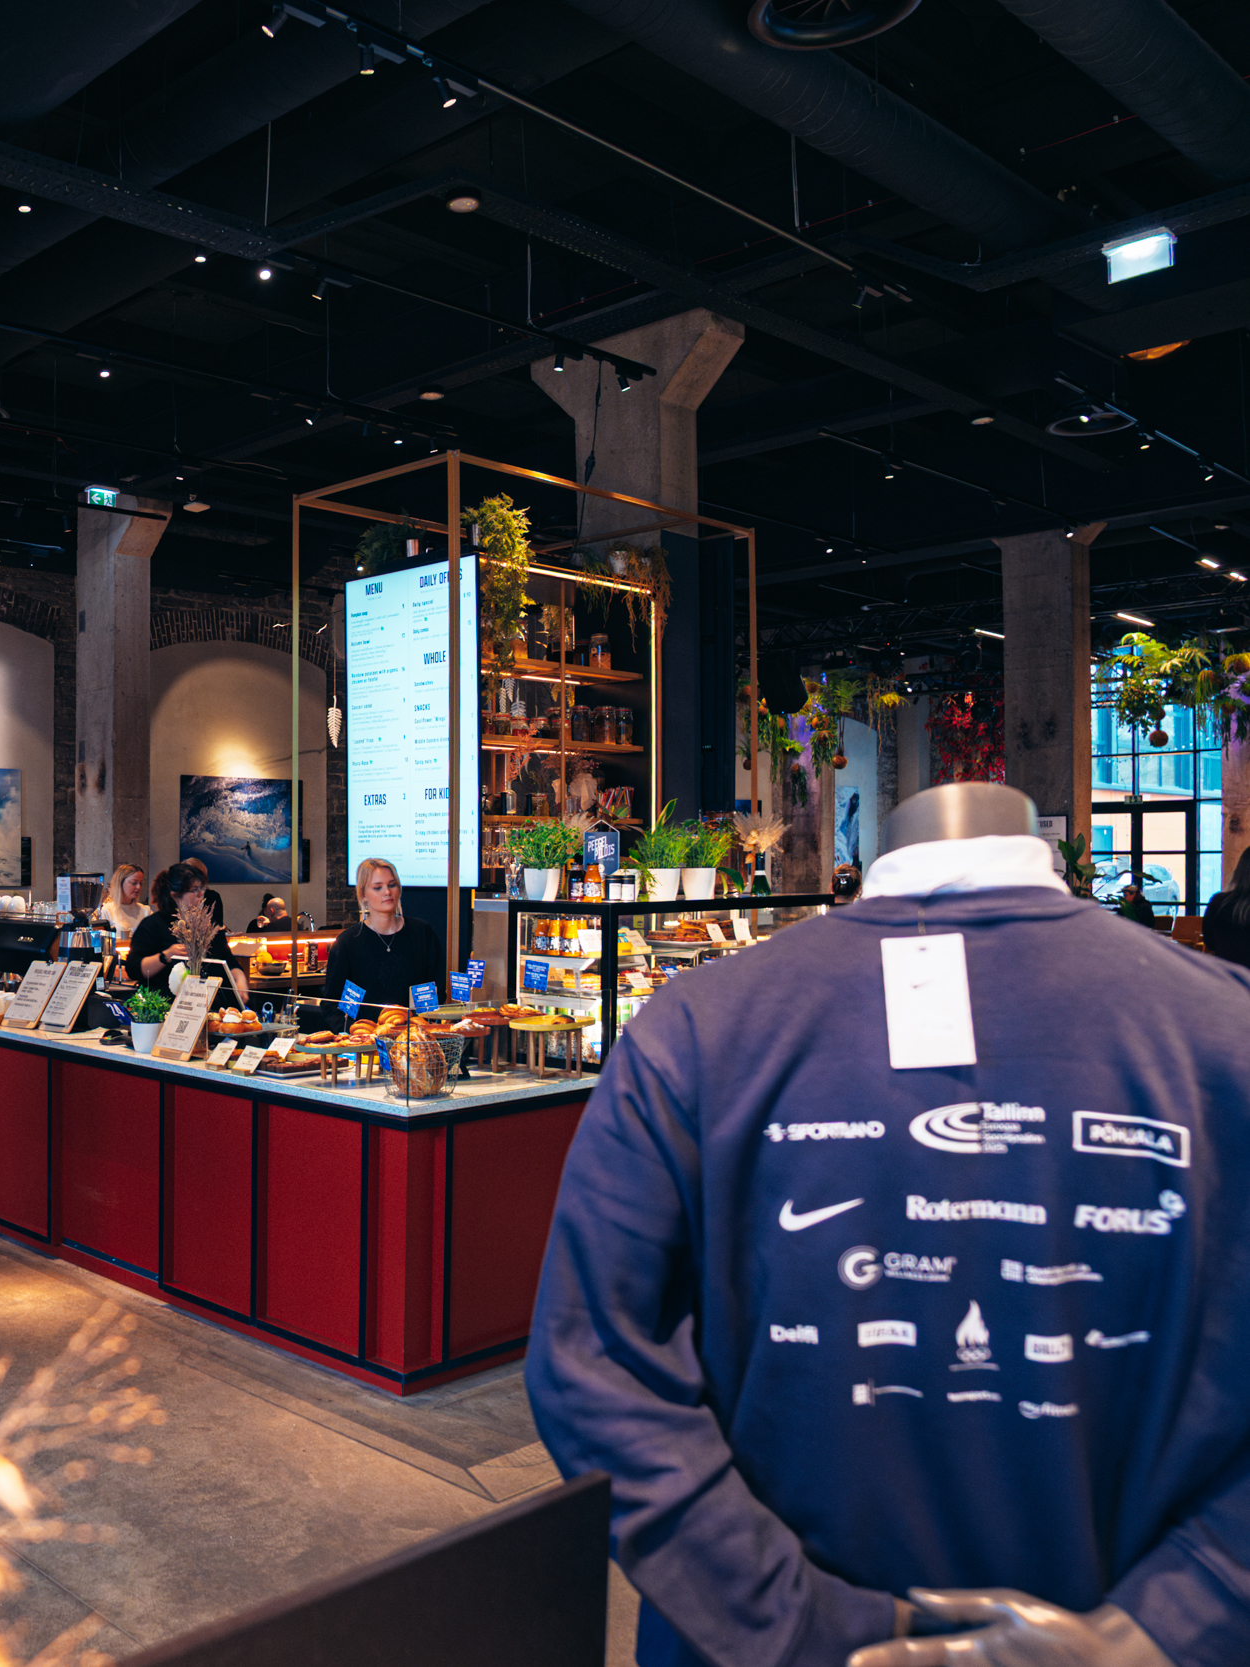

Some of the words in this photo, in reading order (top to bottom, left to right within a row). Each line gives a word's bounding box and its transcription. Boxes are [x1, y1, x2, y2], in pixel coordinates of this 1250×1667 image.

[419, 573, 437, 588] DAILY
[439, 568, 463, 584] OFS
[365, 581, 383, 596] MENU
[423, 650, 447, 665] WHOLE
[414, 703, 431, 712] SNACKS
[363, 794, 387, 806] EXTRAS
[424, 788, 437, 800] FOR
[439, 787, 450, 799] KID
[979, 1102, 1046, 1122] Tallinn
[905, 1195, 1047, 1225] Rotermann
[1073, 1204, 1172, 1236] FORUS
